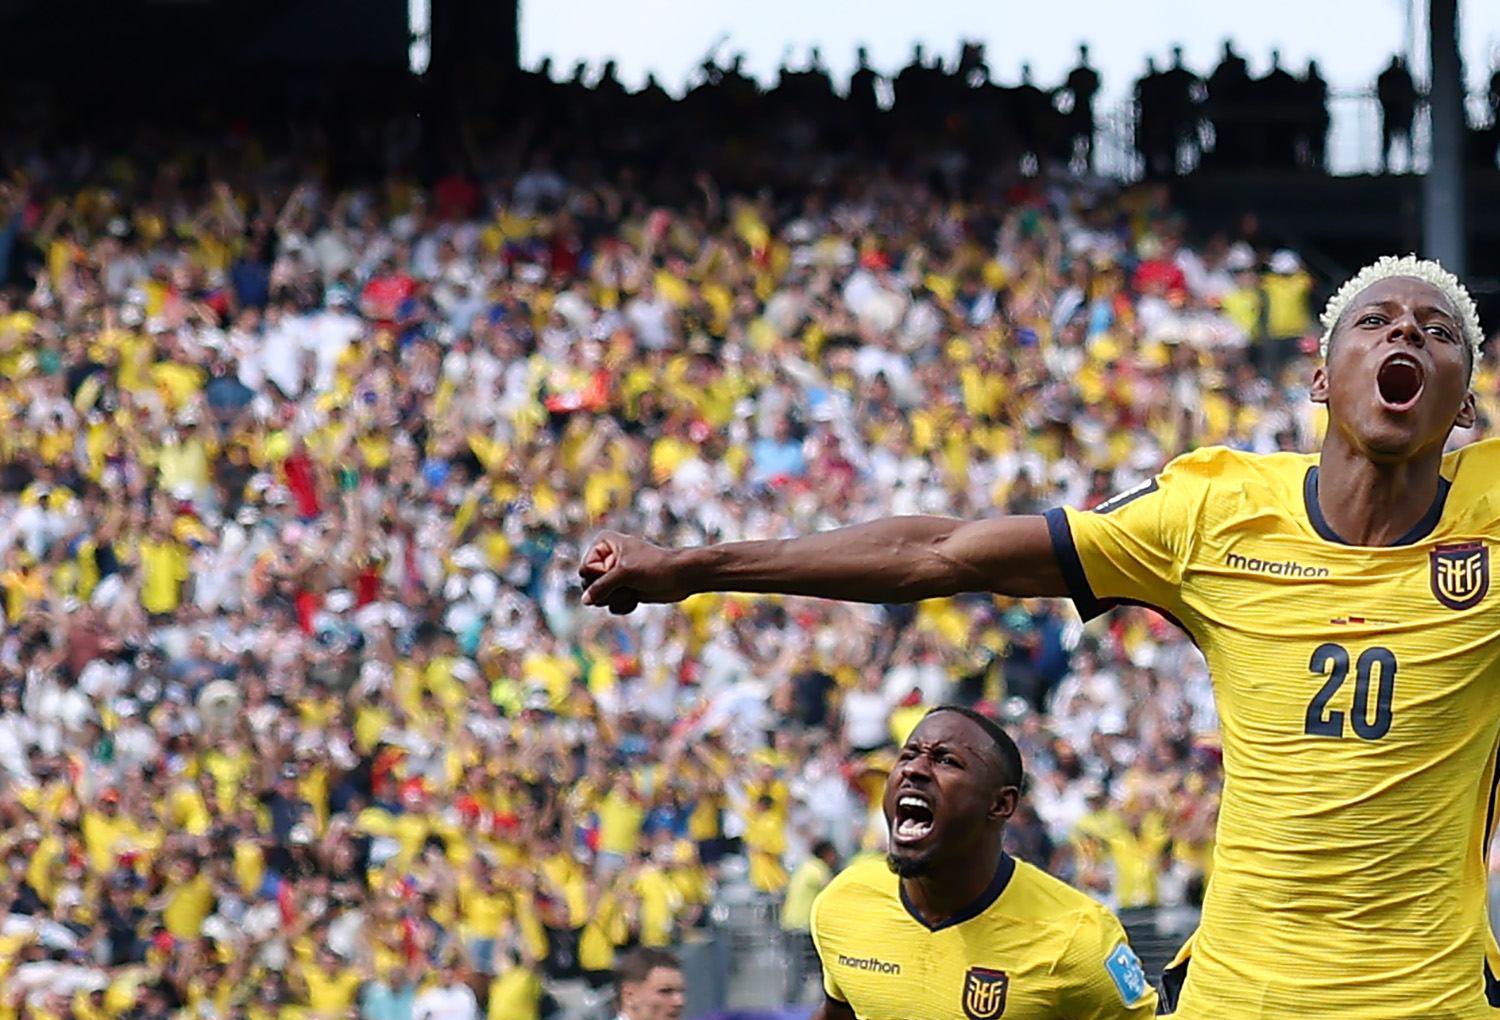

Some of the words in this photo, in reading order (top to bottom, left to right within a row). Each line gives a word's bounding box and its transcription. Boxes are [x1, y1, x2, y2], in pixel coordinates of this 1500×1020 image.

[1226, 553, 1329, 577] marathon
[1304, 643, 1398, 740] 20
[838, 954, 901, 975] marathon
